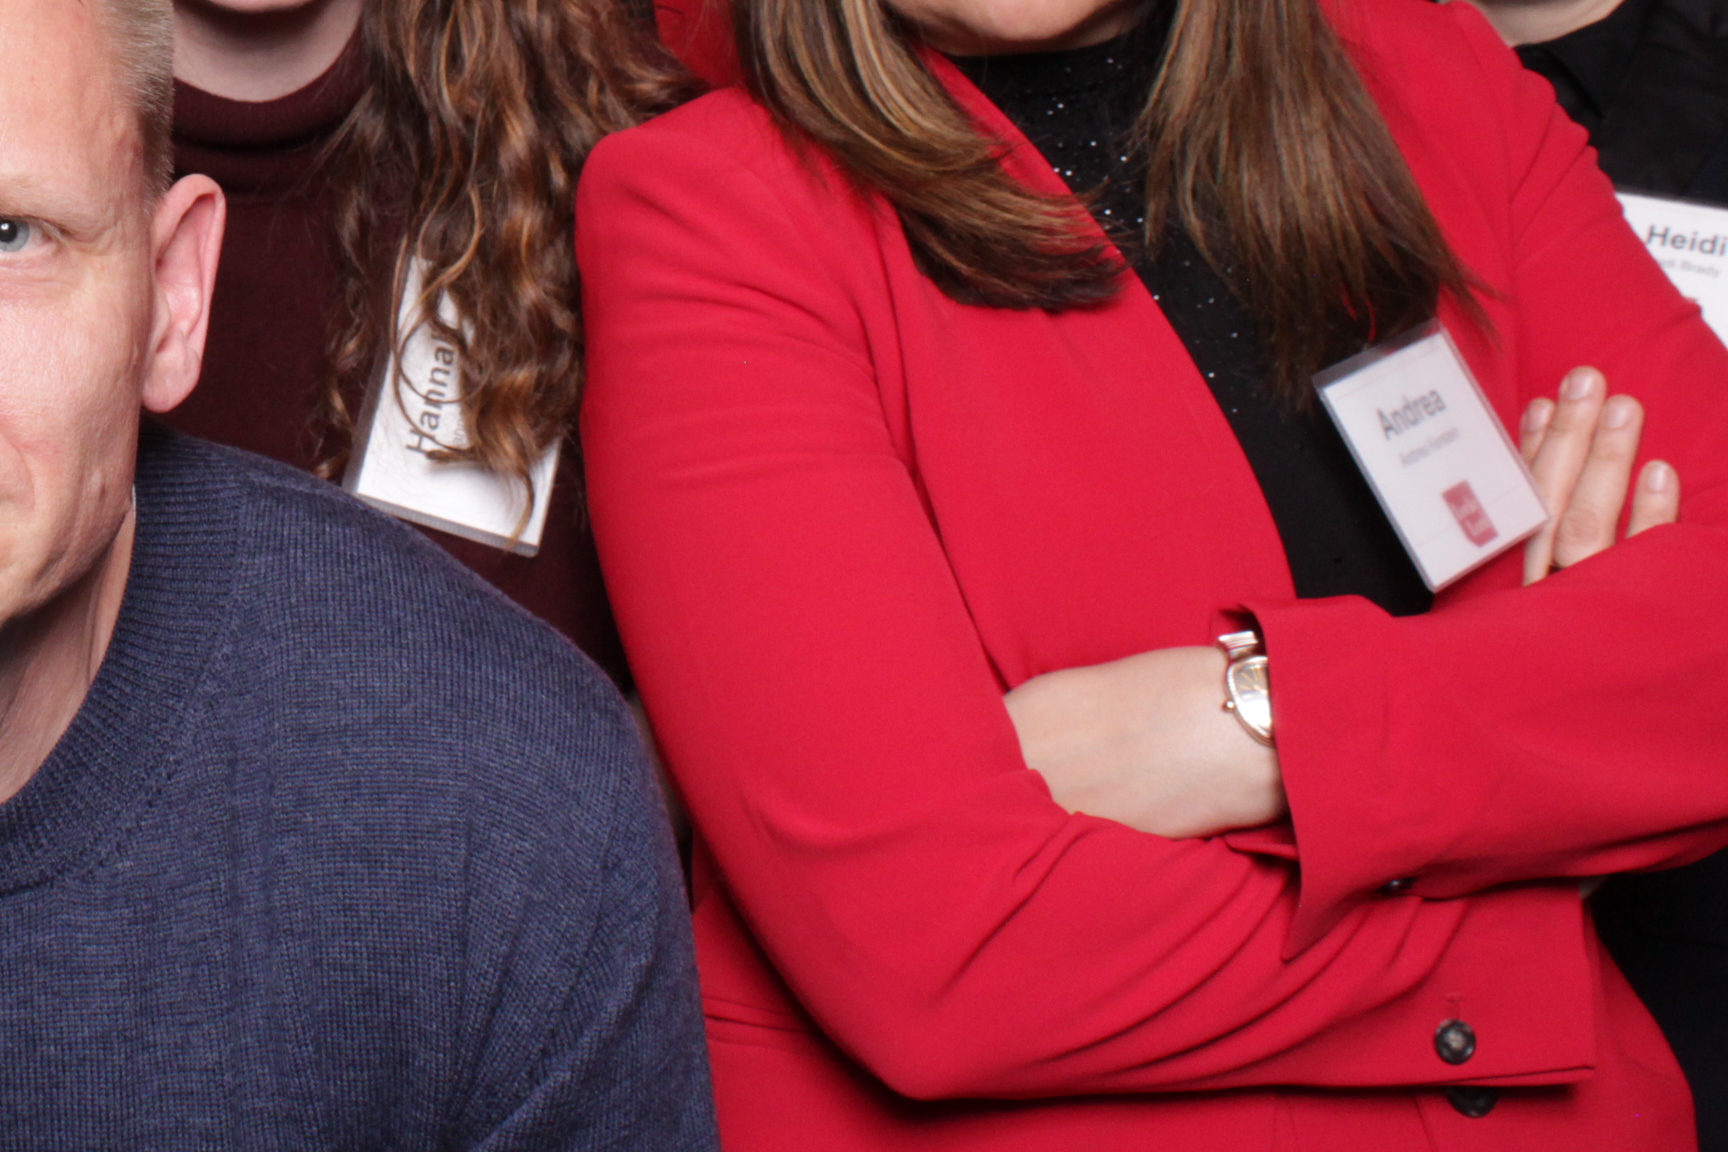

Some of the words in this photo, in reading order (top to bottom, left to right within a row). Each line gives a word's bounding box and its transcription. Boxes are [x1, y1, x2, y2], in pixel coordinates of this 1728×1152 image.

[1646, 224, 1727, 257] Heidi
[406, 335, 454, 455] Hanna
[1376, 390, 1446, 441] Andrea
